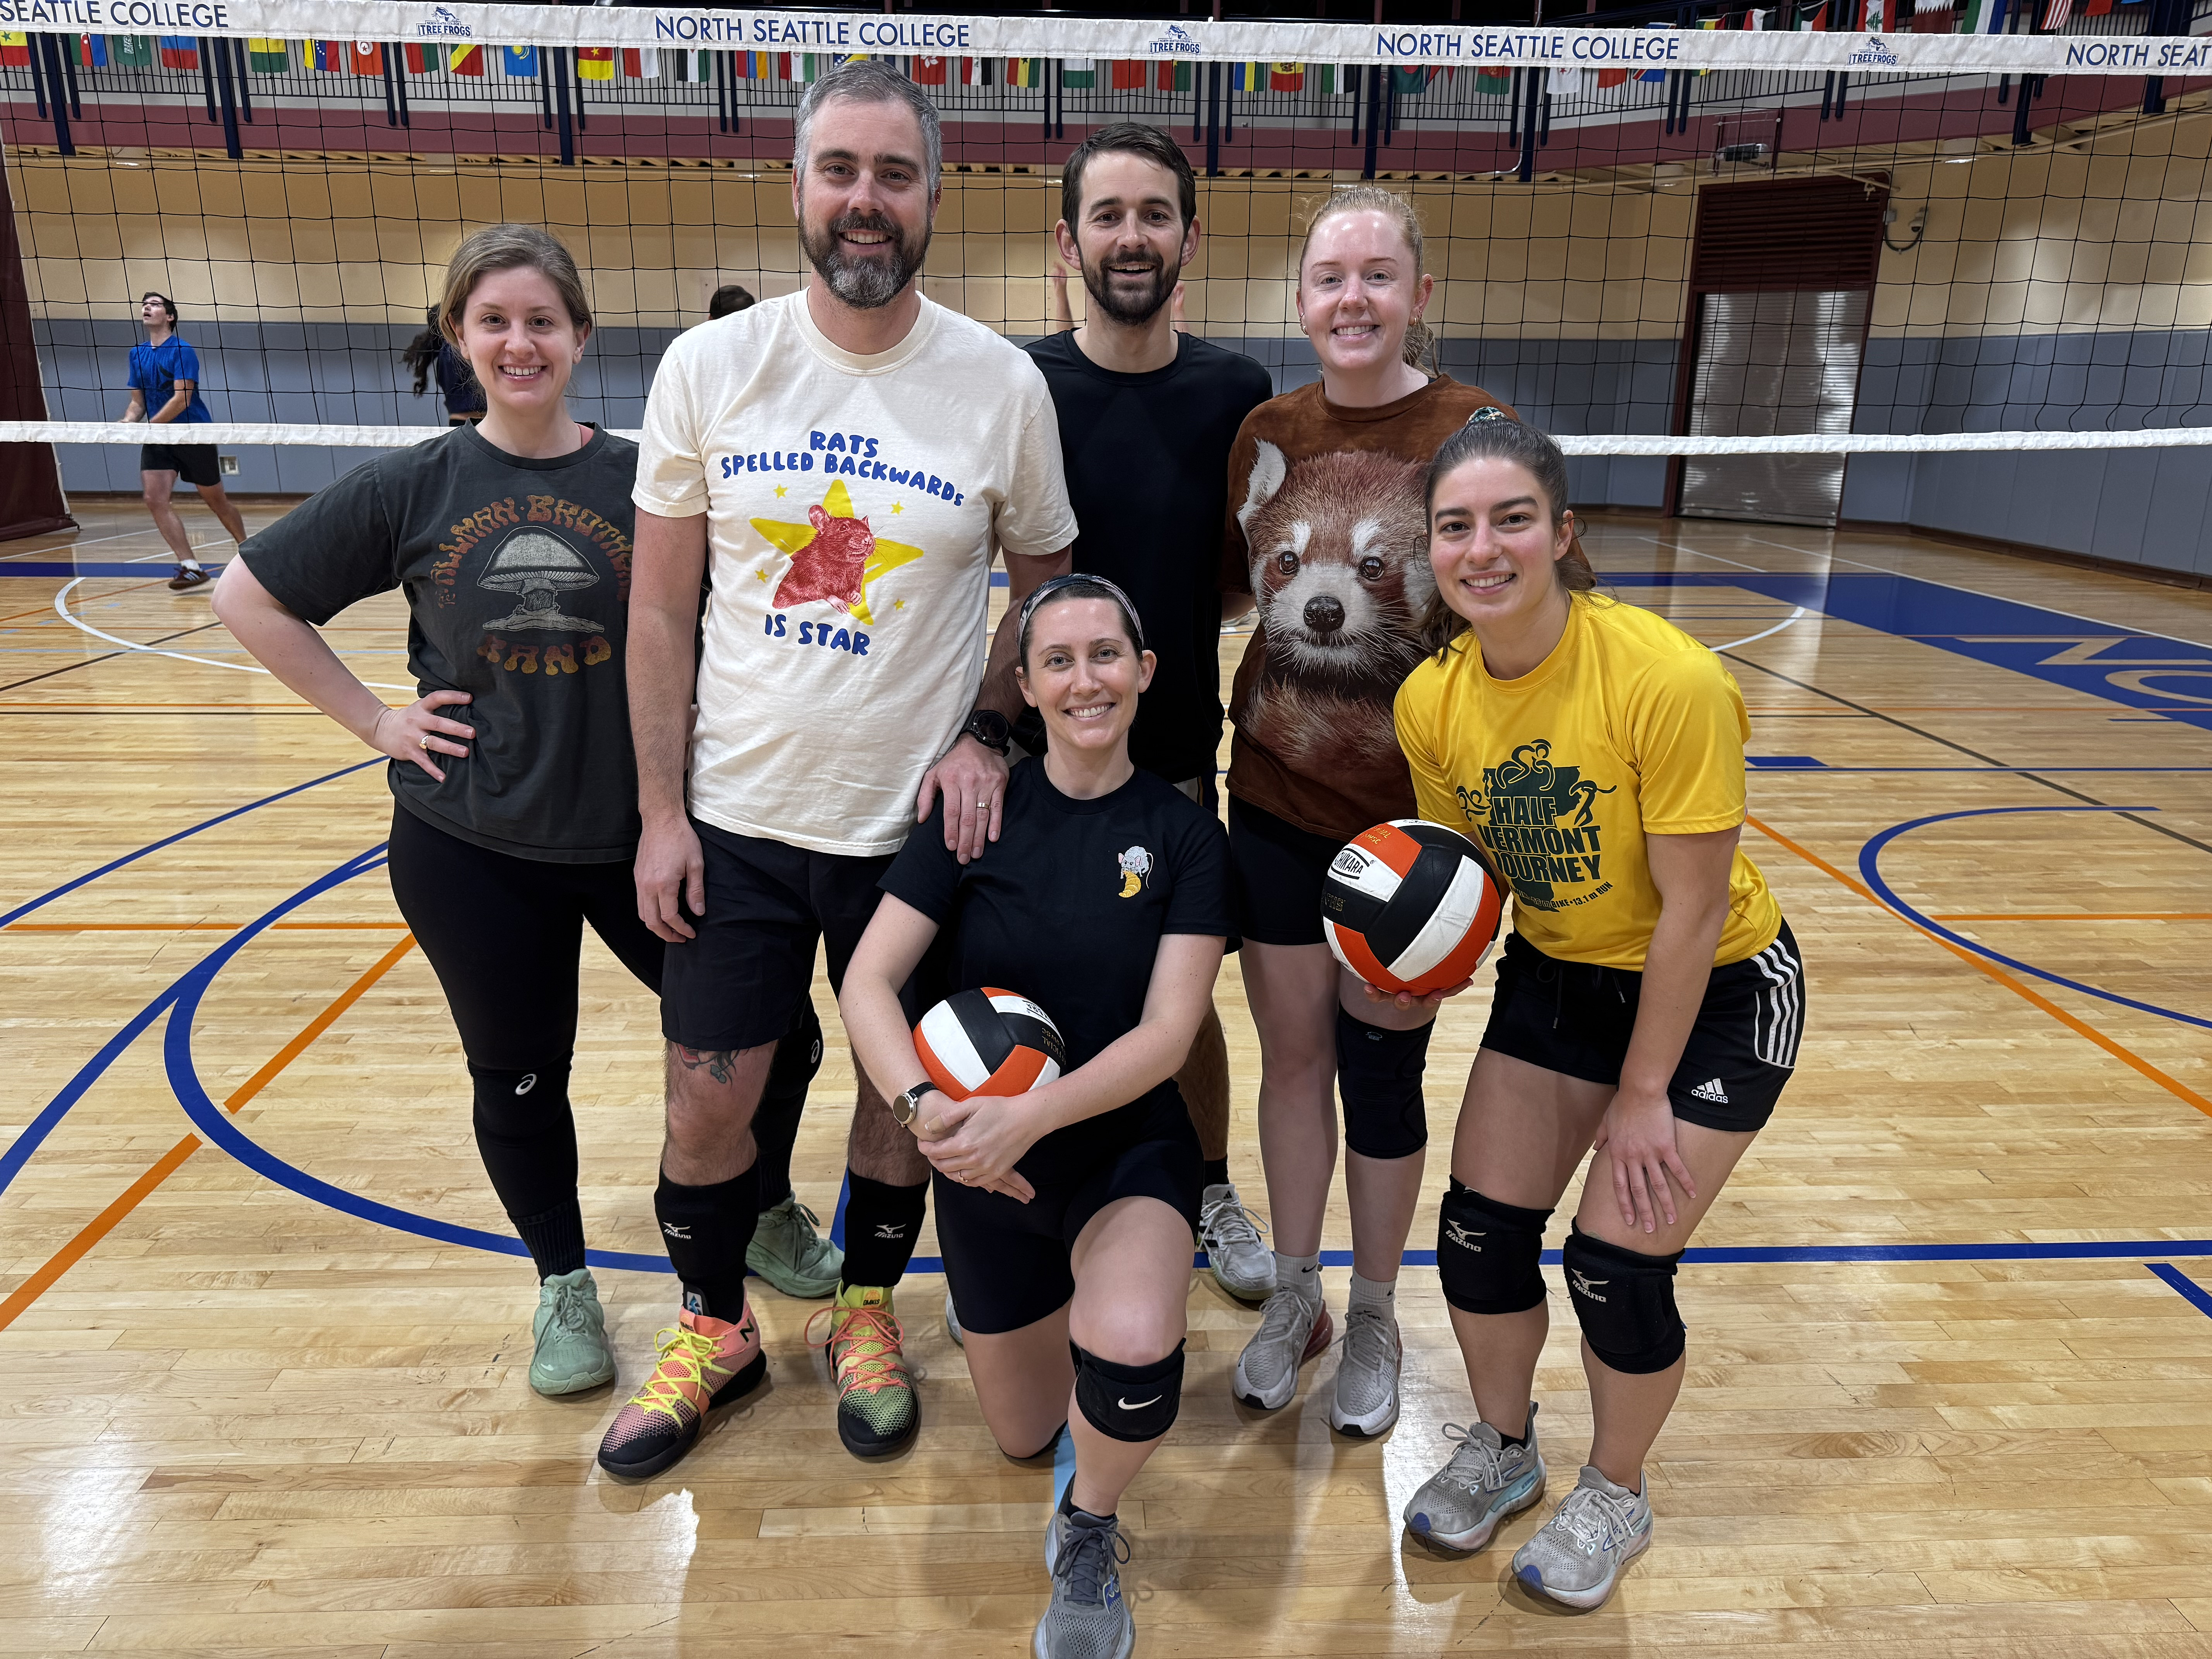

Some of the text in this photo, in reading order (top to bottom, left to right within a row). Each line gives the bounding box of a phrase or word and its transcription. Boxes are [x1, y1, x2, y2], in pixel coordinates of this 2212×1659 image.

[0, 0, 229, 27] SEATTLE COLLEGE
[420, 25, 442, 35] TREE
[444, 25, 471, 36] FROGS
[656, 15, 969, 47] NORTH SEATTLE COLLEGE
[1153, 43, 1173, 52] TREE
[1175, 43, 1200, 53] FROGS
[1377, 32, 1679, 60] NORTH SEATTLE COLLEGE
[1852, 54, 1872, 63] TREE
[1873, 54, 1897, 65] FROGS
[2066, 43, 2150, 67] NORTH
[810, 431, 879, 458] RATS
[721, 452, 964, 507] SPELLED BACKWARDS
[765, 614, 870, 656] IS STAR
[1492, 797, 1557, 826] HALF
[1477, 826, 1601, 855] VERMONT
[1491, 851, 1601, 883] JOURNEY
[1595, 881, 1614, 895] RUN
[1691, 1089, 1728, 1104] adidas
